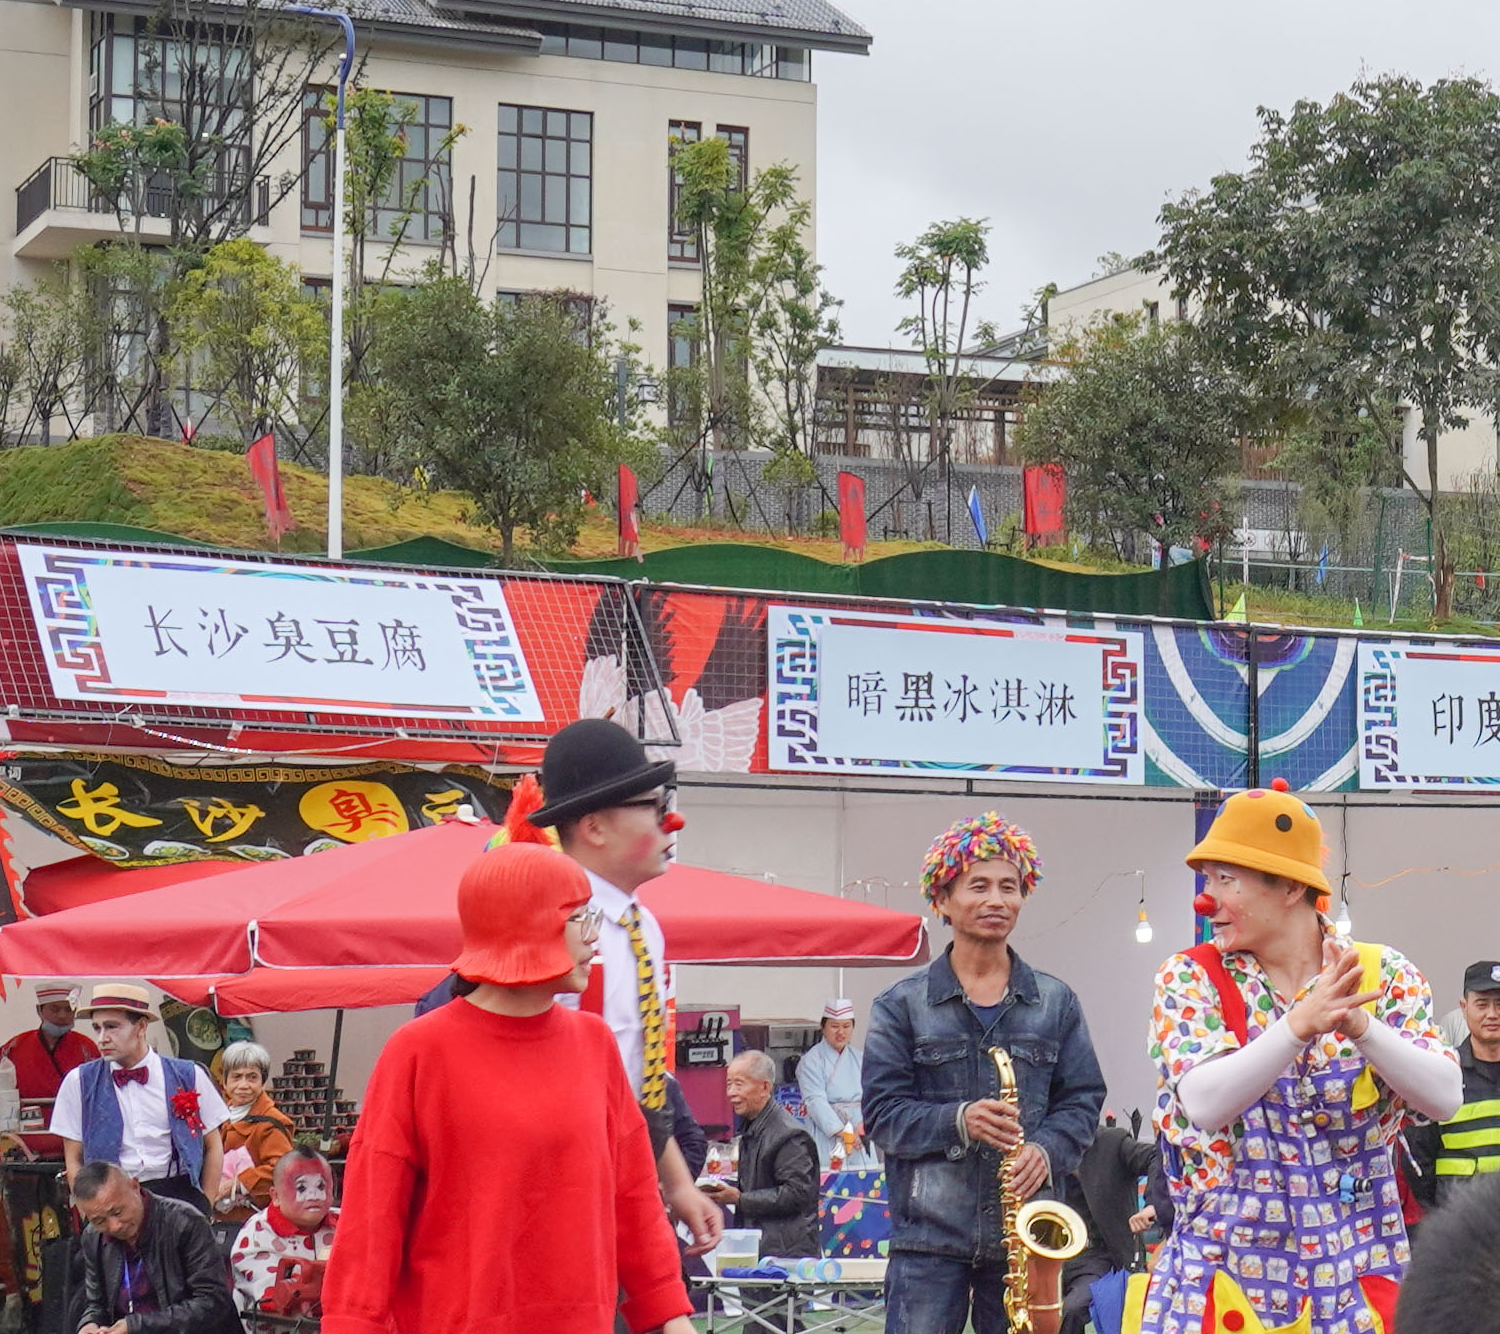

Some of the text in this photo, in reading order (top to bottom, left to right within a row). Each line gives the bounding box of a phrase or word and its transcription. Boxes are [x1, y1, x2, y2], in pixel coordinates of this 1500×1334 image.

[144, 604, 427, 671] 长沙臭豆腐
[847, 670, 1077, 726] 暗黑冰淇淋
